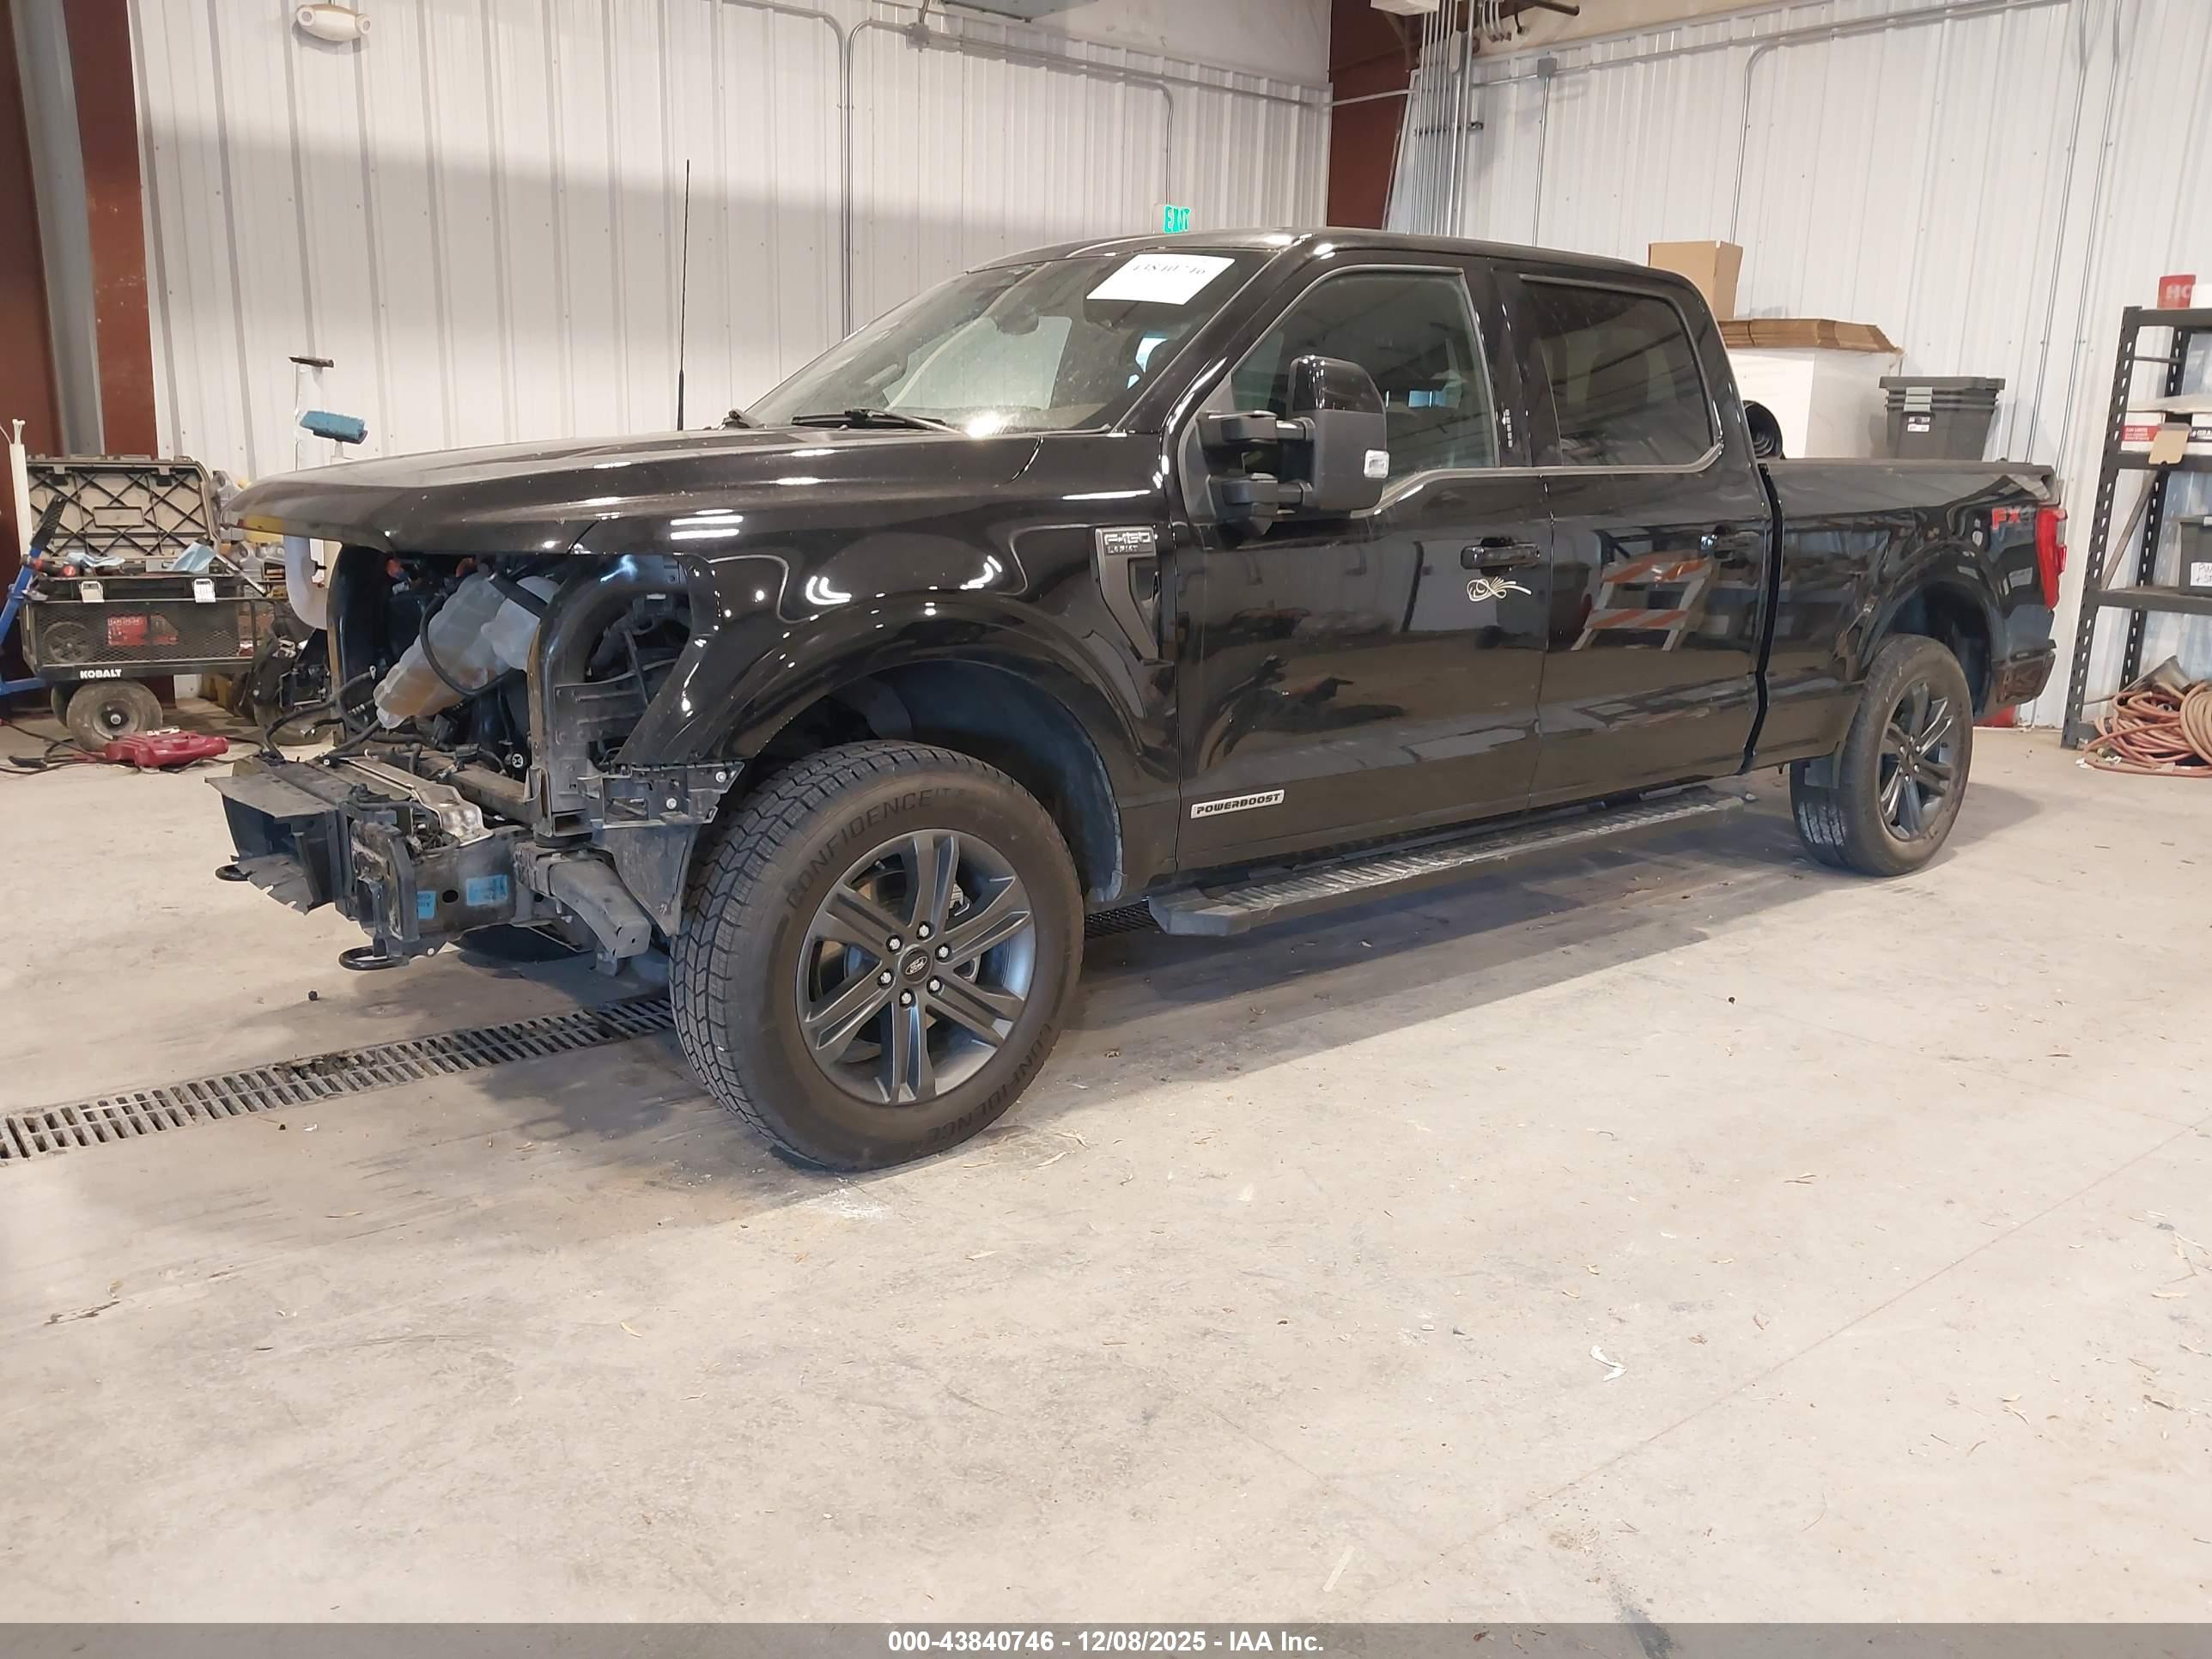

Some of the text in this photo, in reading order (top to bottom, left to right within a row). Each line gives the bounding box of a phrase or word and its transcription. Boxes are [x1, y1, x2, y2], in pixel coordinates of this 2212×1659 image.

[1164, 205, 1190, 233] EXIT
[1991, 505, 2037, 531] FX4
[1104, 532, 1151, 545] F-150
[80, 669, 122, 679] KOBALT
[1196, 793, 1280, 815] POWERBOOST
[786, 788, 933, 909] CONFIDENCE
